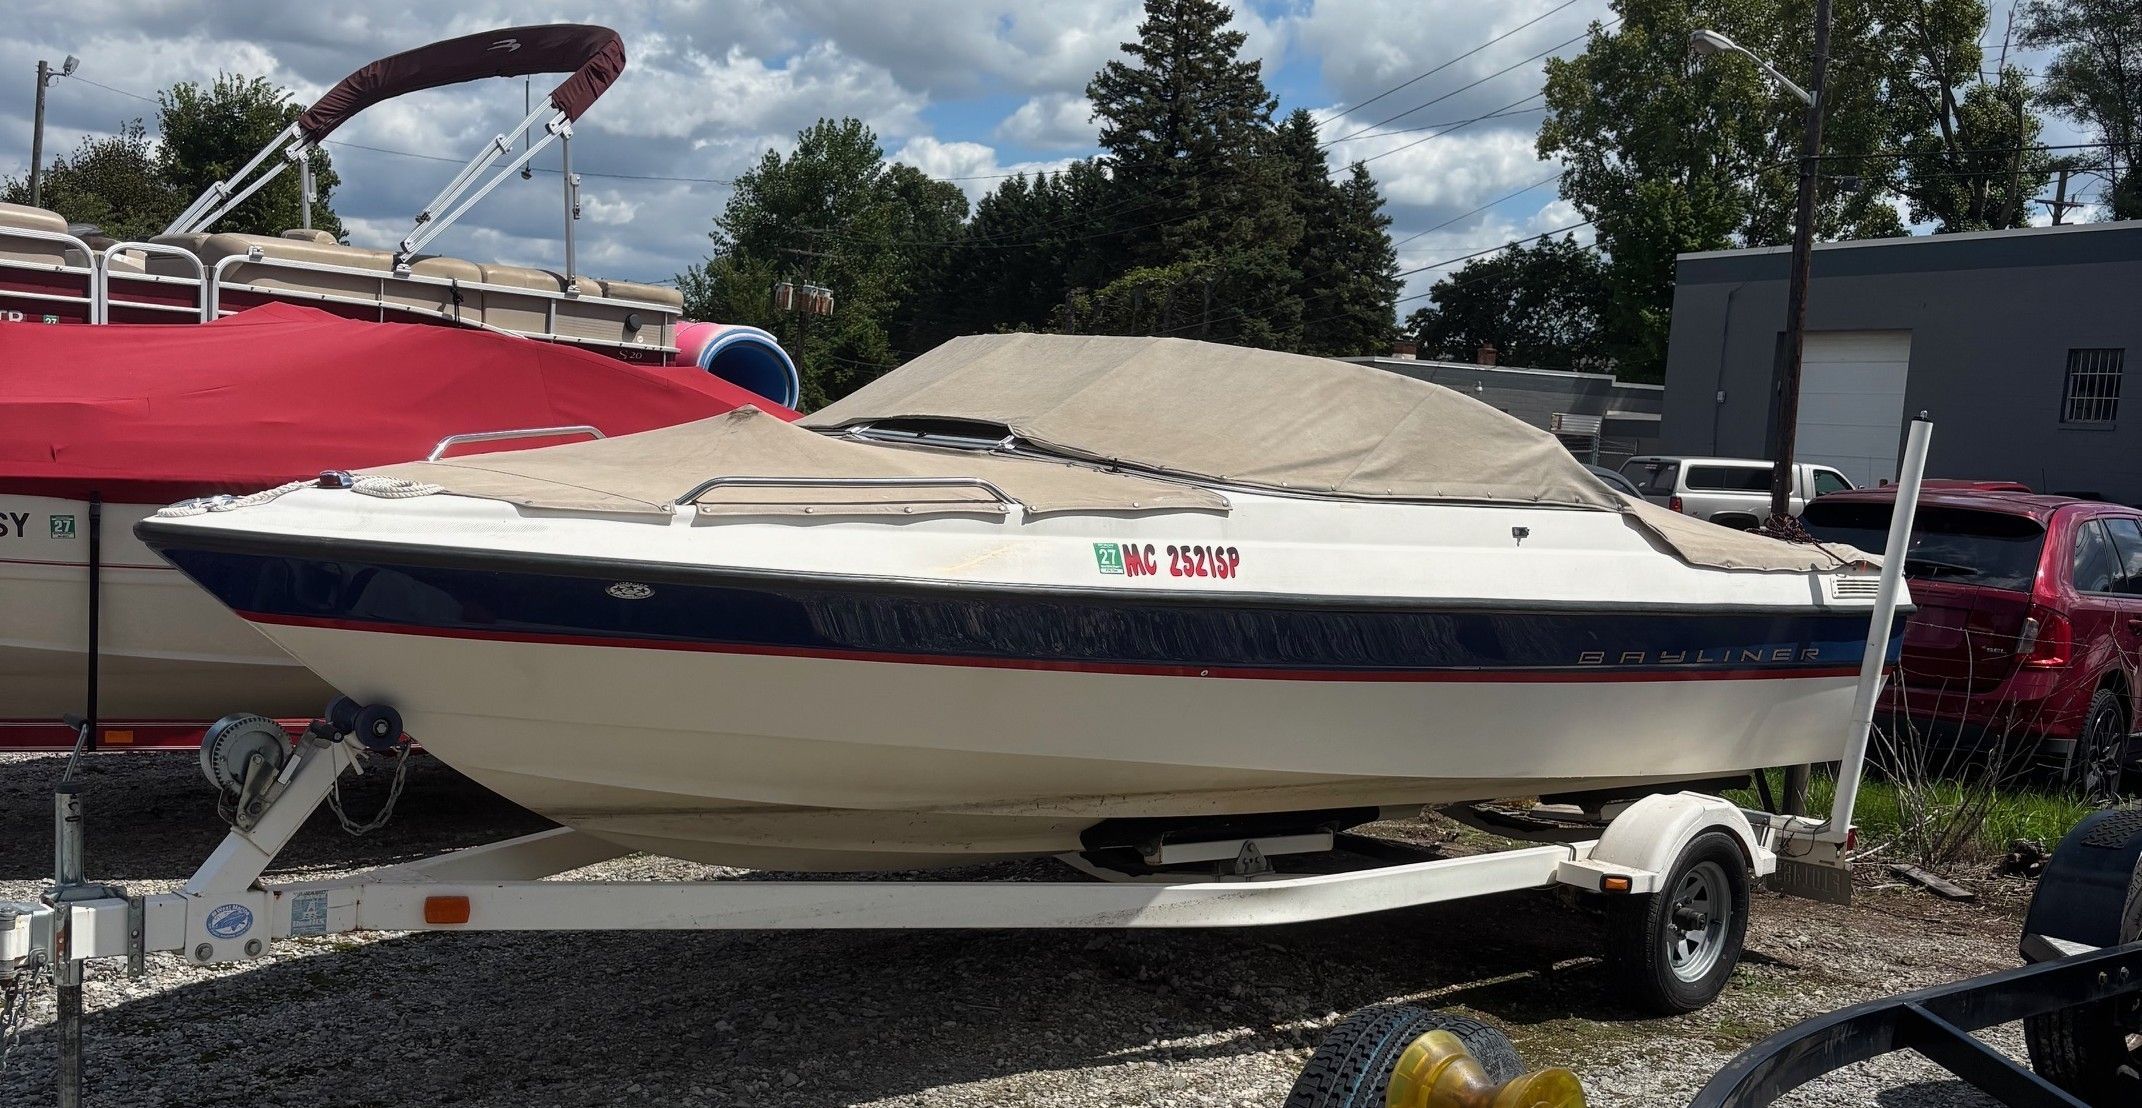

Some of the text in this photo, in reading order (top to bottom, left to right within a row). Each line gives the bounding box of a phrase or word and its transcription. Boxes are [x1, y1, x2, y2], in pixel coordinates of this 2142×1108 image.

[54, 520, 71, 532] 27
[1099, 548, 1116, 565] 27
[1122, 543, 1157, 577] MC
[1577, 647, 1820, 664] BAYLINER
